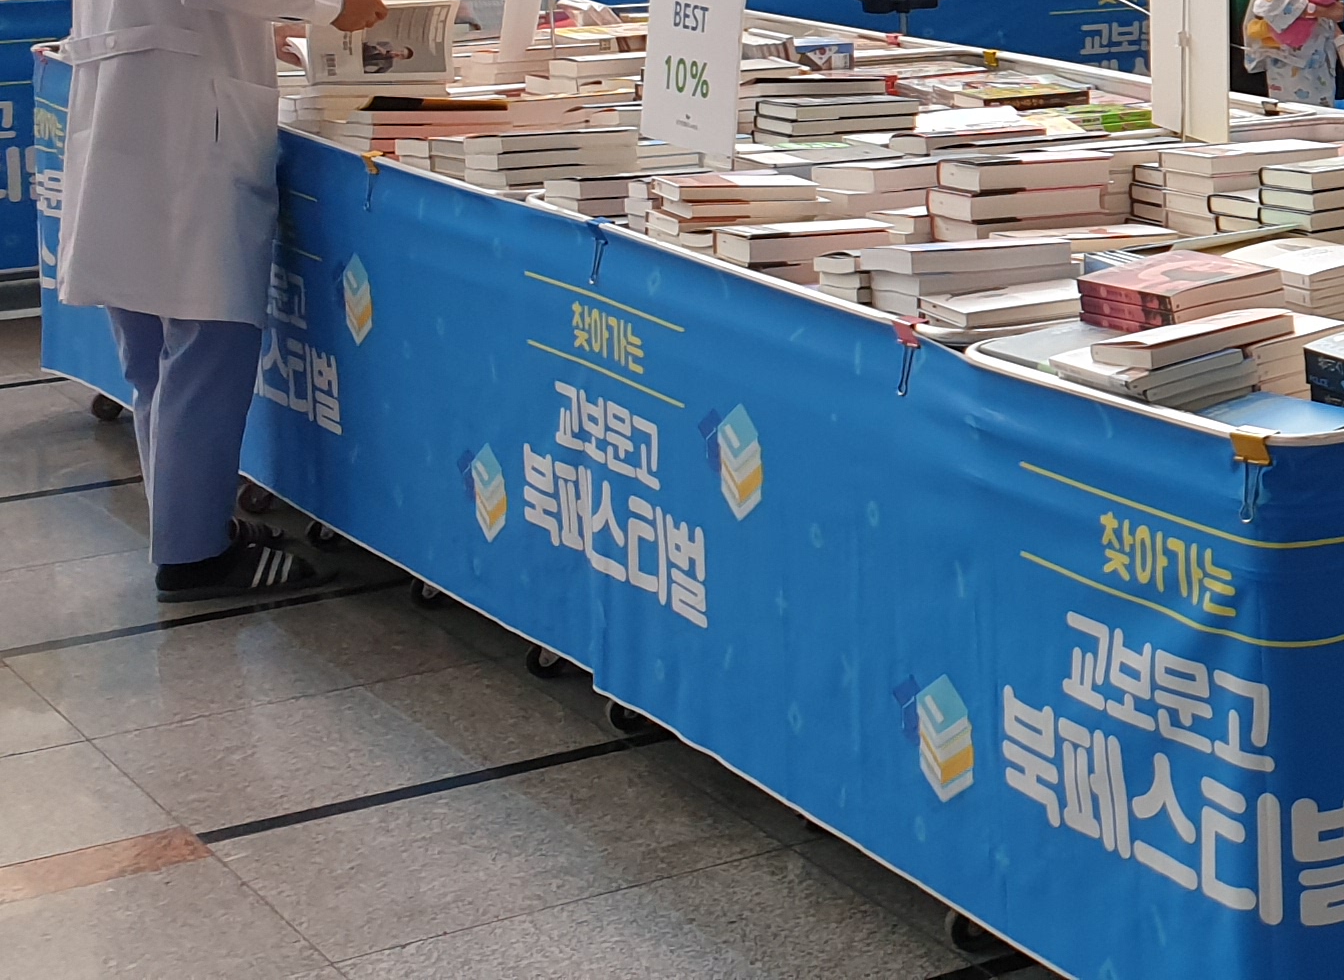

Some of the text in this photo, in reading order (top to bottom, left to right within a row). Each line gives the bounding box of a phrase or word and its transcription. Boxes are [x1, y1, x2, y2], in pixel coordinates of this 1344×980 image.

[673, 0, 709, 33] BEST
[1080, 20, 1150, 55] 교보
[665, 54, 710, 99] 10%
[254, 328, 343, 436] 스티벌
[570, 300, 644, 376] 찾아가는
[554, 379, 661, 491] 교보문고
[523, 443, 709, 629] 북페스티벌
[1100, 511, 1236, 617] 찾아가는
[1061, 611, 1276, 772] 교보문고
